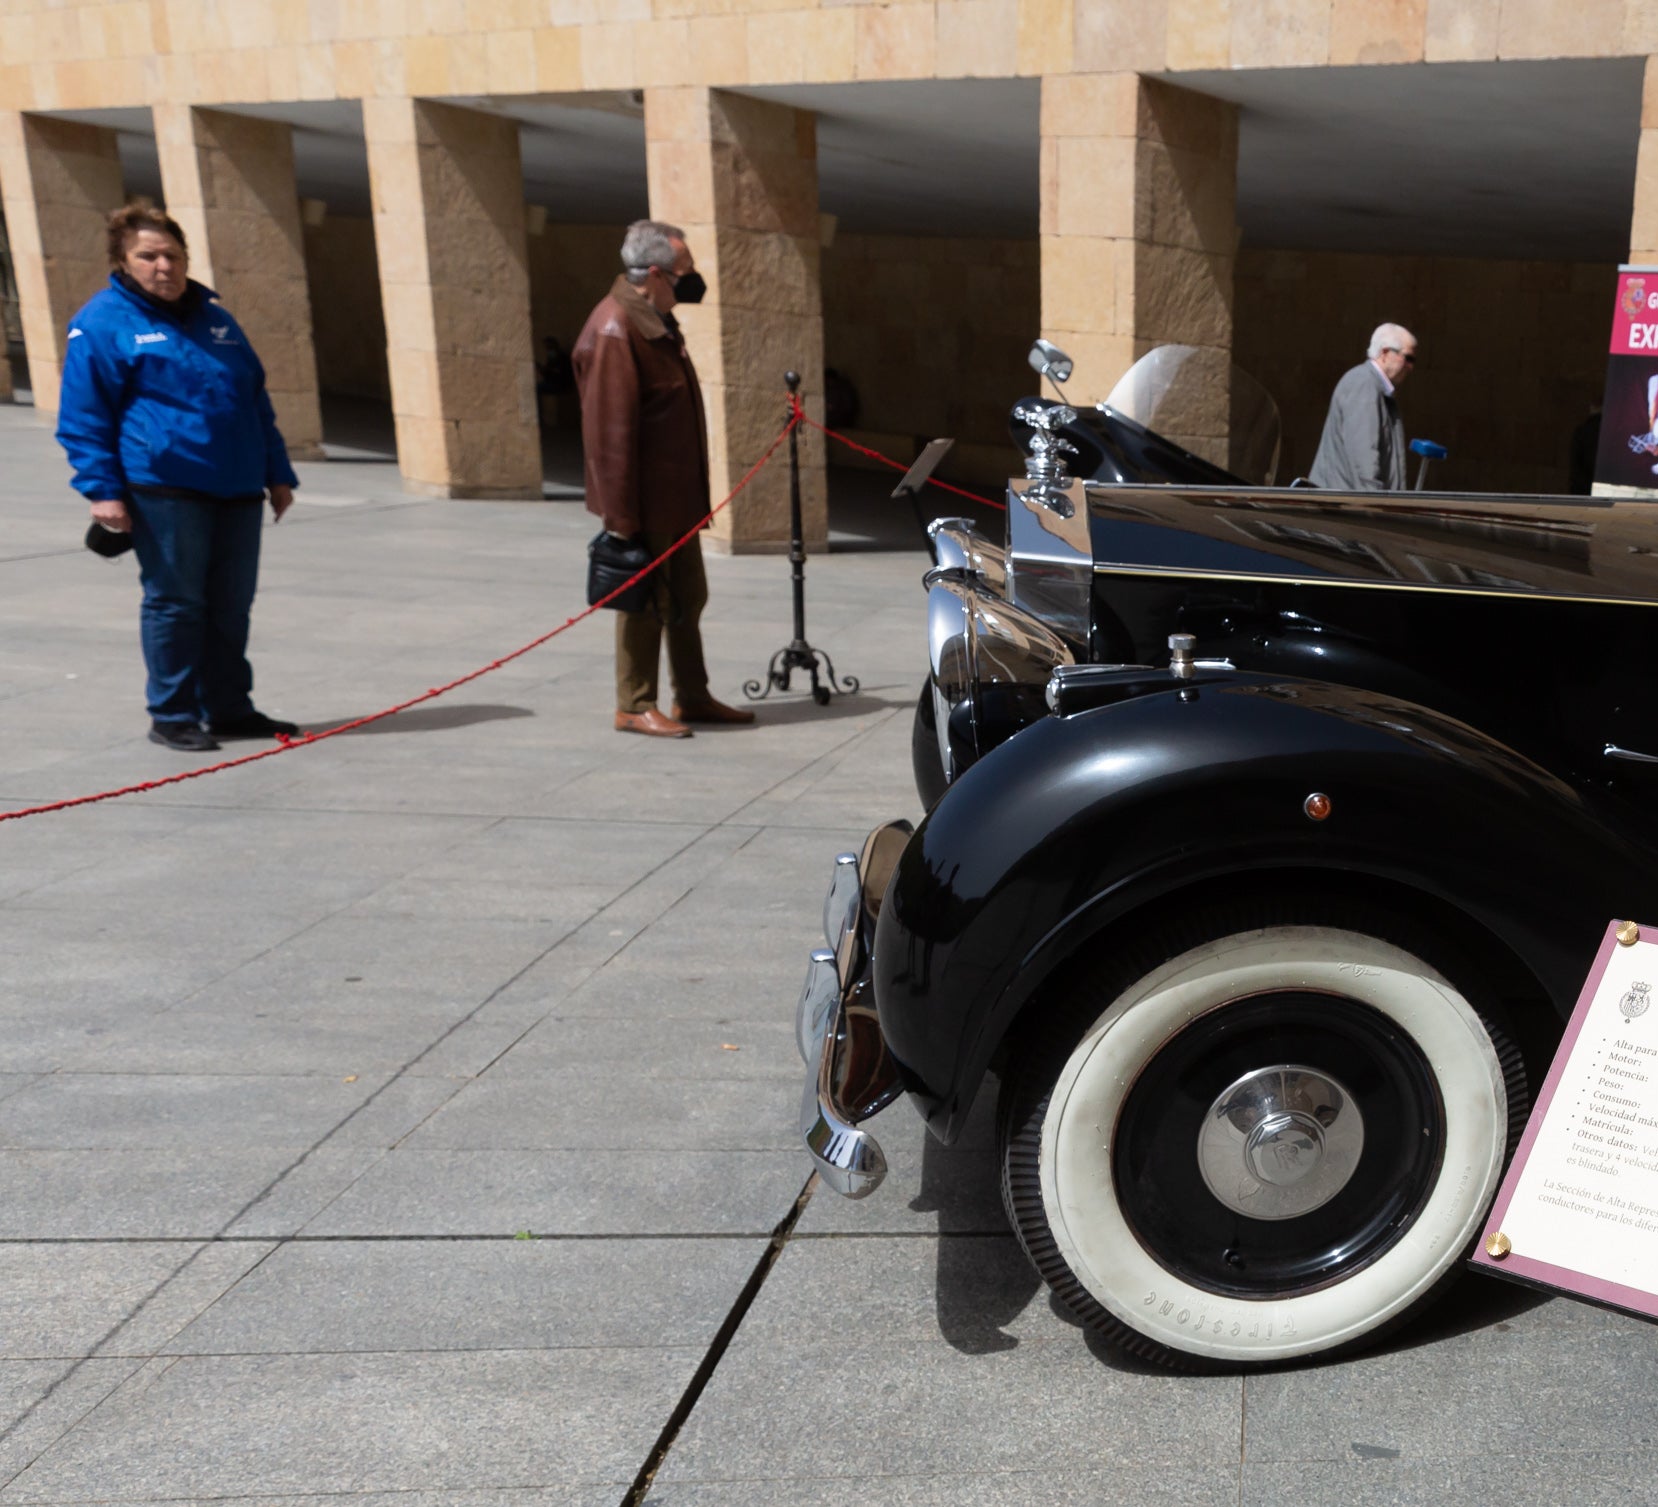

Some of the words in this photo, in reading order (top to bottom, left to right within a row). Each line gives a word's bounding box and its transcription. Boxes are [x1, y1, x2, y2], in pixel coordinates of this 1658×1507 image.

[1613, 1038, 1634, 1049] Alta
[1634, 1046, 1658, 1055] para
[1608, 1051, 1643, 1065] Motor:
[1603, 1064, 1650, 1081] Potencia:
[1598, 1077, 1625, 1089] Peso:
[1592, 1089, 1642, 1108] Consumo:
[1587, 1102, 1637, 1121] Velocidad
[1582, 1116, 1635, 1136] Matrícula:
[1576, 1128, 1604, 1142] Otros
[1607, 1136, 1639, 1151] datos:
[1566, 1156, 1577, 1165] es
[1571, 1141, 1605, 1157] trasera
[1605, 1153, 1613, 1163] y
[1614, 1152, 1622, 1163] 4
[1543, 1177, 1555, 1189] La
[1556, 1181, 1592, 1198] Sección
[1592, 1191, 1606, 1203] de
[1606, 1195, 1626, 1208] Alta
[1537, 1194, 1595, 1214] conductores
[1595, 1210, 1618, 1221] para
[1619, 1214, 1633, 1226] los
